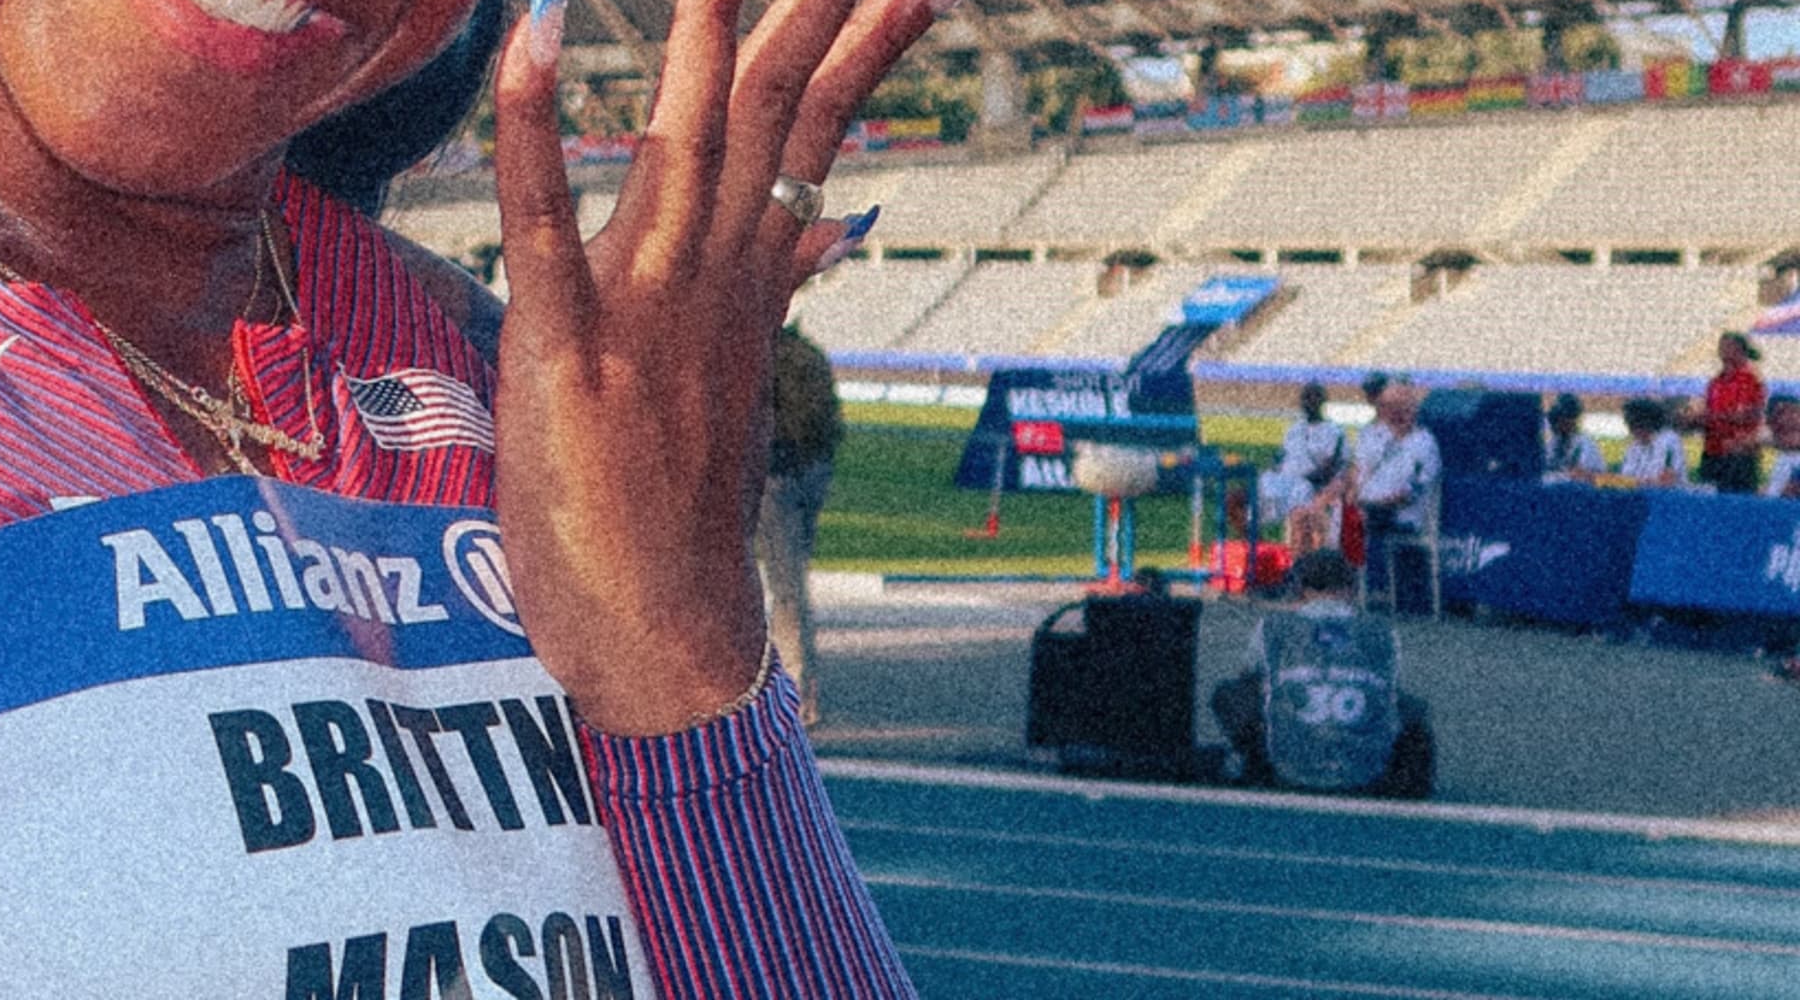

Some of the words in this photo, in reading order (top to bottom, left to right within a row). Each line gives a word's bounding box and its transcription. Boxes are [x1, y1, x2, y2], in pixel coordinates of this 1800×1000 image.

[101, 509, 450, 631] Allianz
[1297, 683, 1366, 725] 30
[207, 694, 600, 854] BRITTN
[285, 911, 635, 1000] MASON
